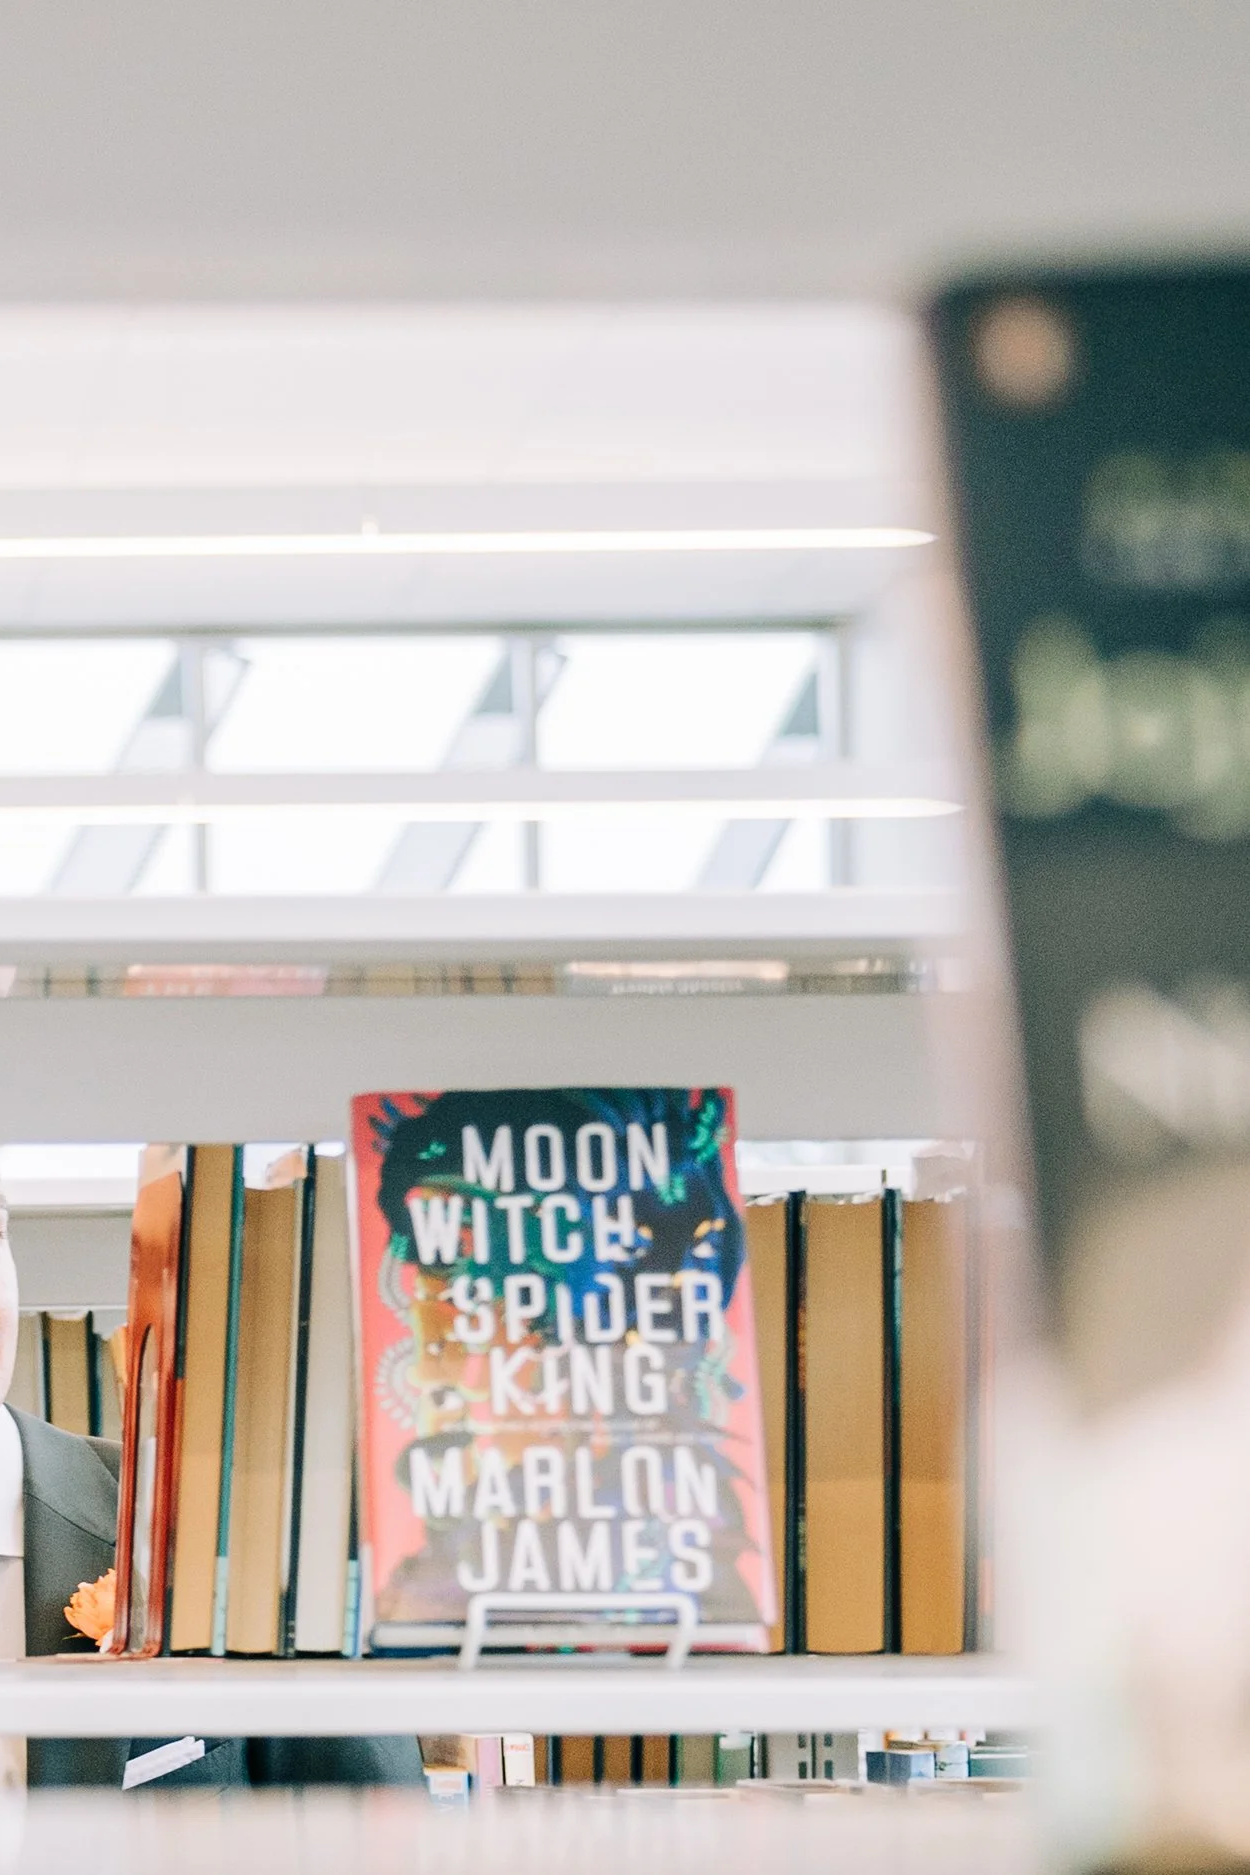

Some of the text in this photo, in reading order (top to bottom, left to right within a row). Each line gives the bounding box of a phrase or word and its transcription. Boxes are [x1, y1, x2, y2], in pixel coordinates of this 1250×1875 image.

[461, 1122, 671, 1194] MOON
[408, 1194, 637, 1266] WITCH
[452, 1272, 725, 1345] SPIDER
[488, 1343, 668, 1416] KING
[409, 1446, 719, 1519] MARLON
[456, 1519, 714, 1593] JAMES
